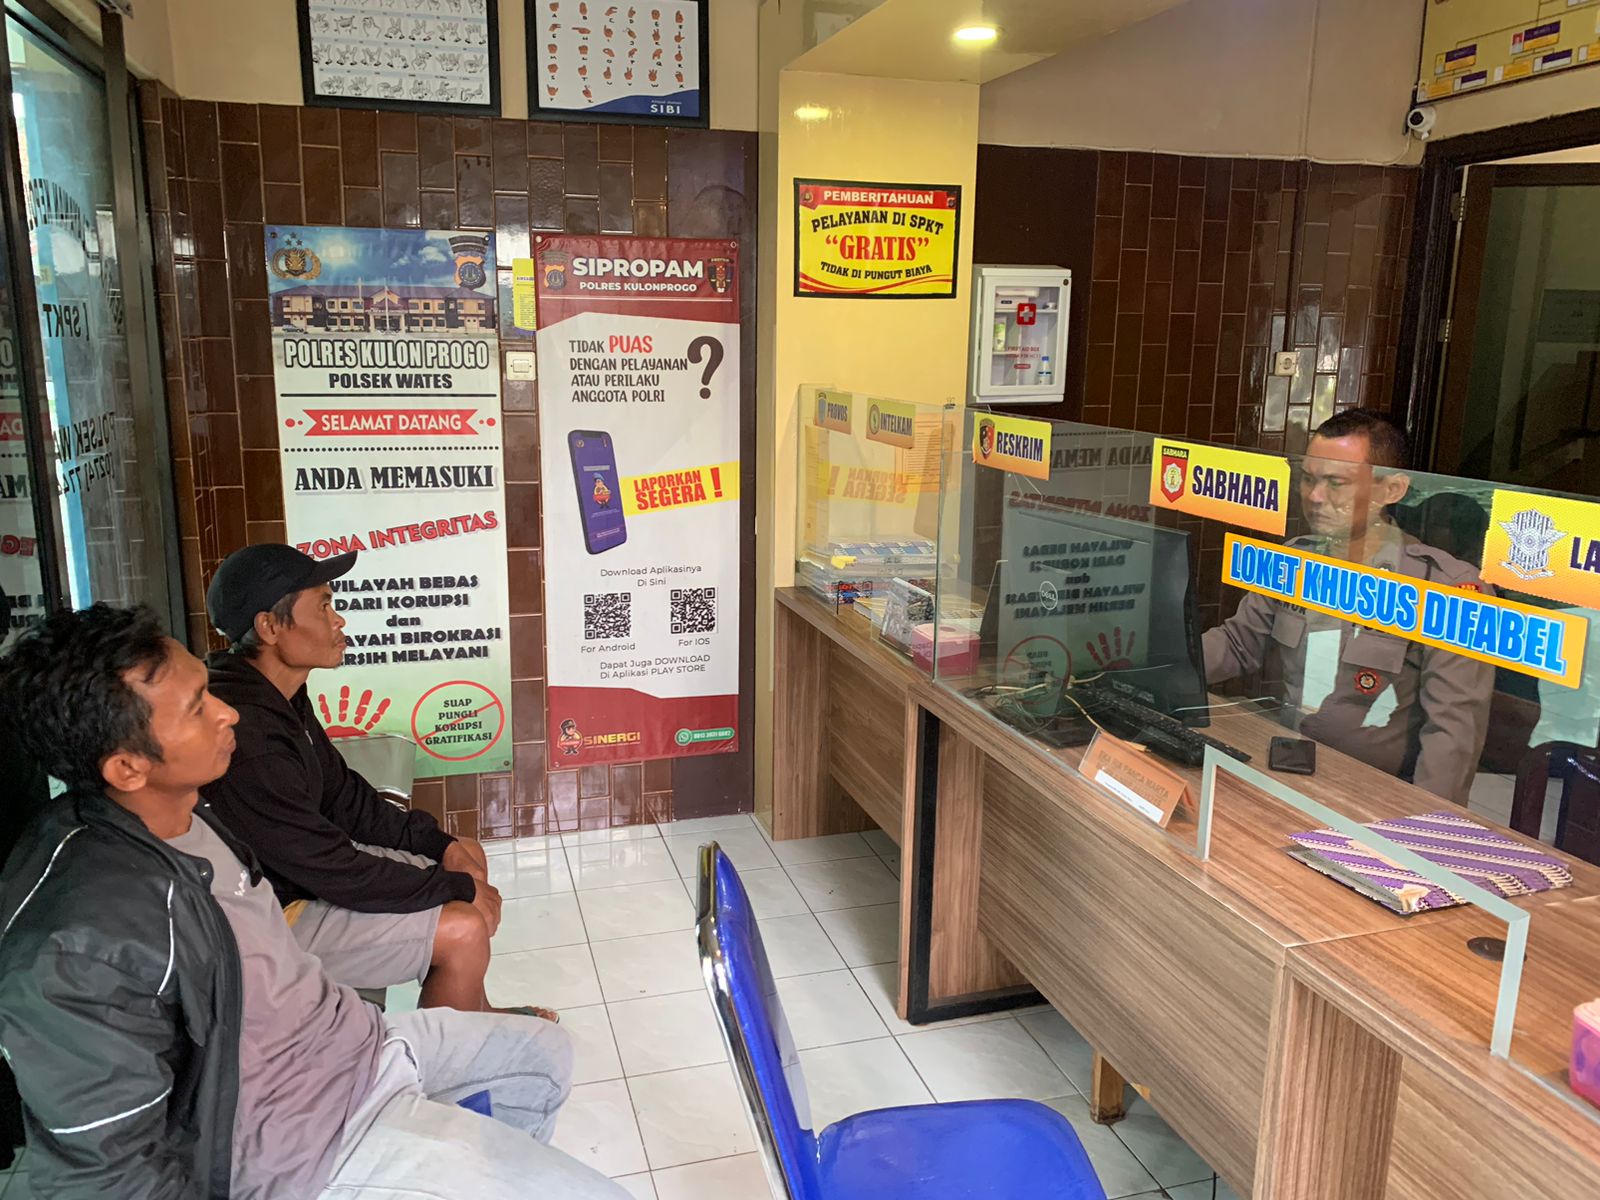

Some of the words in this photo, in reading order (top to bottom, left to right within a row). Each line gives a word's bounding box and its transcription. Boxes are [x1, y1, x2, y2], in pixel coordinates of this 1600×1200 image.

[650, 104, 680, 114] SIBI
[824, 190, 934, 204] PEMBERITAHUAN
[812, 210, 888, 232] PELAYANAN
[892, 213, 906, 226] DI
[910, 214, 944, 235] SPKT
[572, 258, 703, 278] SIPROPAM
[820, 262, 849, 276] TIDAK
[852, 270, 862, 278] DI
[864, 270, 902, 280] PUNGUT
[906, 264, 932, 276] BIAYA
[580, 282, 621, 291] POLRES
[624, 282, 697, 292] KULONPROGO
[568, 340, 605, 354] TIDAK
[608, 335, 653, 354] PUAS
[284, 339, 357, 368] POLRES
[360, 340, 424, 368] KULON
[425, 340, 490, 368] PROGO
[570, 358, 617, 370] DENGAN
[621, 358, 688, 371] PELAYANAN
[687, 336, 724, 400] ?
[329, 374, 392, 388] POLSEK
[396, 374, 452, 388] WATES
[571, 374, 600, 387] ATAU
[604, 374, 660, 387] PERILAKU
[572, 390, 628, 402] ANGGOTA
[632, 390, 665, 402] POLRI
[322, 414, 394, 431] SELAMAT
[398, 414, 462, 430] DATANG
[880, 413, 912, 436] INTELKAM
[996, 431, 1044, 462] RESKRIM
[1164, 447, 1188, 458] SABHARA
[295, 467, 363, 491] ANDA
[371, 465, 494, 489] MEMASUKI
[634, 470, 701, 492] LAPORKAN
[710, 467, 722, 498] !
[1192, 465, 1278, 512] SABHARA
[636, 483, 706, 511] SEGERA
[296, 534, 367, 560] ZONA
[368, 511, 498, 549] INTEGRITAS
[600, 566, 648, 577] Download
[650, 564, 702, 576] Aplikasinya
[420, 576, 478, 590] BEBAS
[637, 578, 648, 587] Di
[649, 578, 666, 586] Sini
[334, 598, 382, 612] DARI
[387, 594, 469, 609] KORUPSI
[1229, 541, 1301, 596] LOKET
[1301, 559, 1419, 631] KHUSUS
[1422, 590, 1568, 676] DIFABEL
[386, 615, 421, 627] dan
[345, 634, 396, 648] AYAH
[400, 628, 501, 644] BIROKRASI
[678, 639, 693, 647] For
[392, 646, 488, 663] MELAYANI
[580, 645, 596, 654] For
[598, 642, 636, 652] Android
[600, 660, 628, 672] Dapat
[630, 659, 652, 670] Juga
[654, 654, 711, 666] DOWNLOAD
[600, 672, 610, 680] Di
[612, 669, 649, 680] Aplikasi
[651, 666, 674, 676] PLAY
[676, 664, 706, 674] STORE
[444, 698, 472, 708] SUAP
[438, 709, 478, 720] PUNGLI
[434, 721, 482, 732] KORUPSI
[425, 732, 492, 745] GRATIFIKASI
[584, 732, 641, 746] SINERGI
